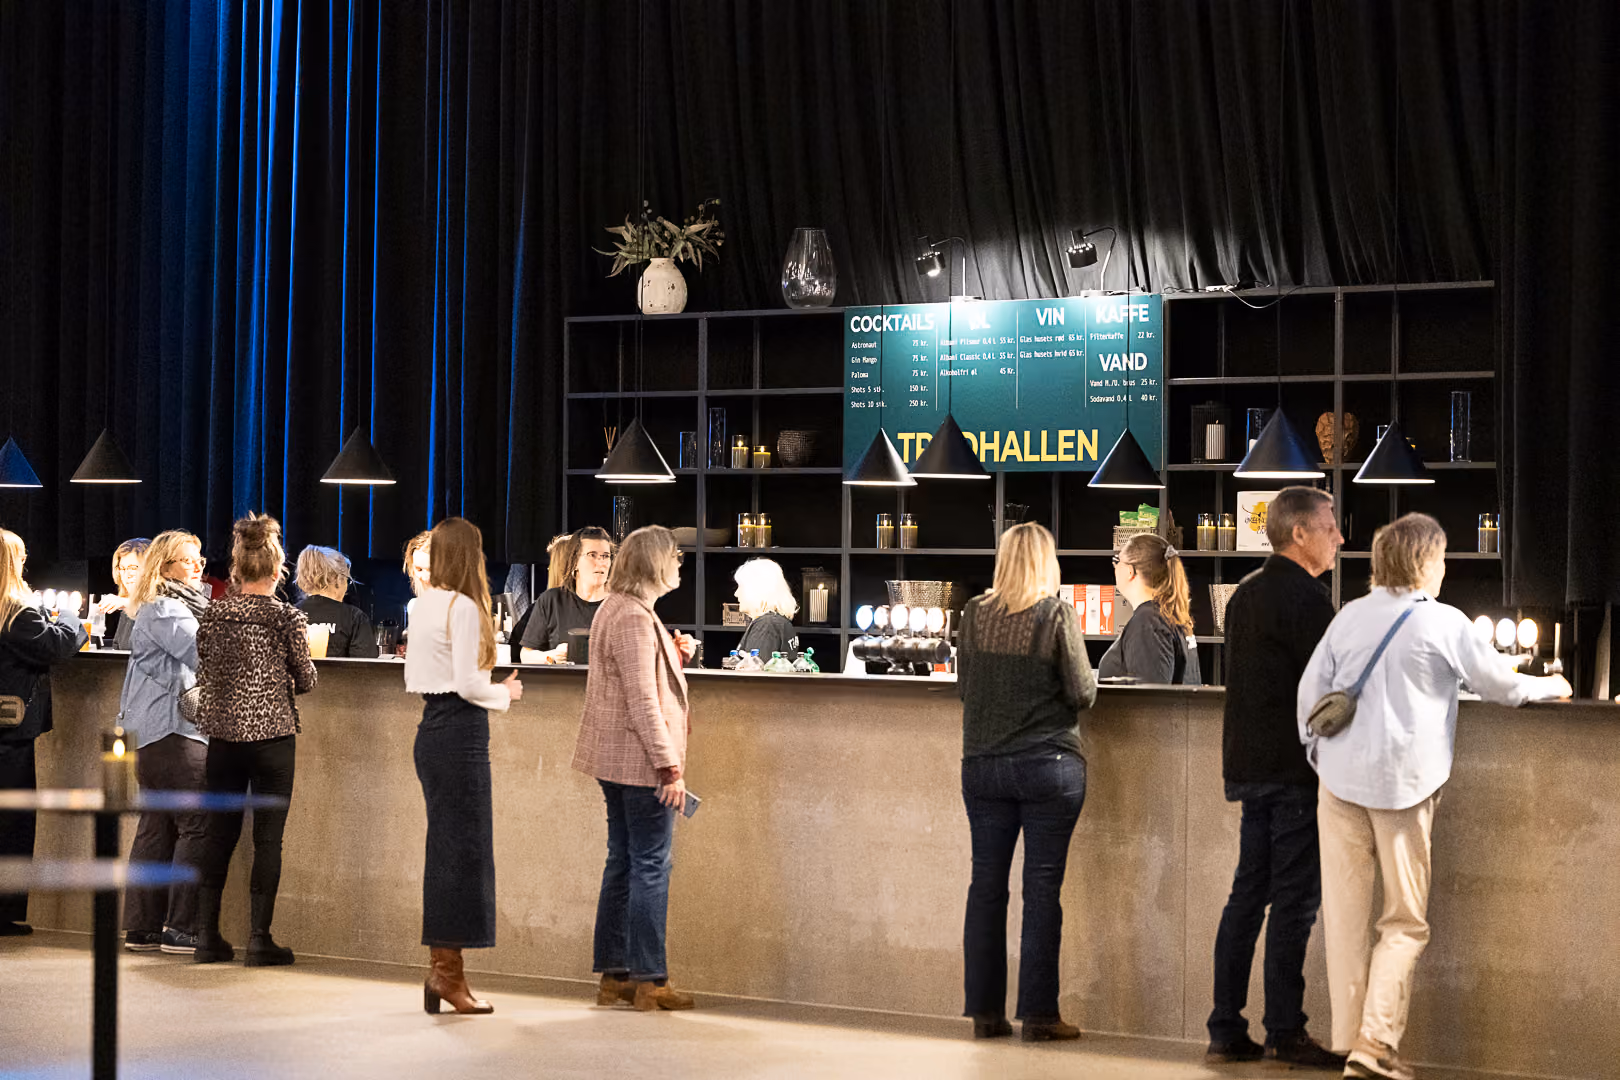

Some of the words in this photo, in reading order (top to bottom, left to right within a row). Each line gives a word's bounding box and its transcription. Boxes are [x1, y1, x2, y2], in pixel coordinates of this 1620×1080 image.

[850, 314, 934, 332] COCKTAILS
[1036, 307, 1064, 326] VIN
[1096, 304, 1149, 323] KAFFE
[862, 356, 878, 364] Mango
[1098, 352, 1148, 372] VAND
[897, 430, 1098, 464] TRDHALLEN
